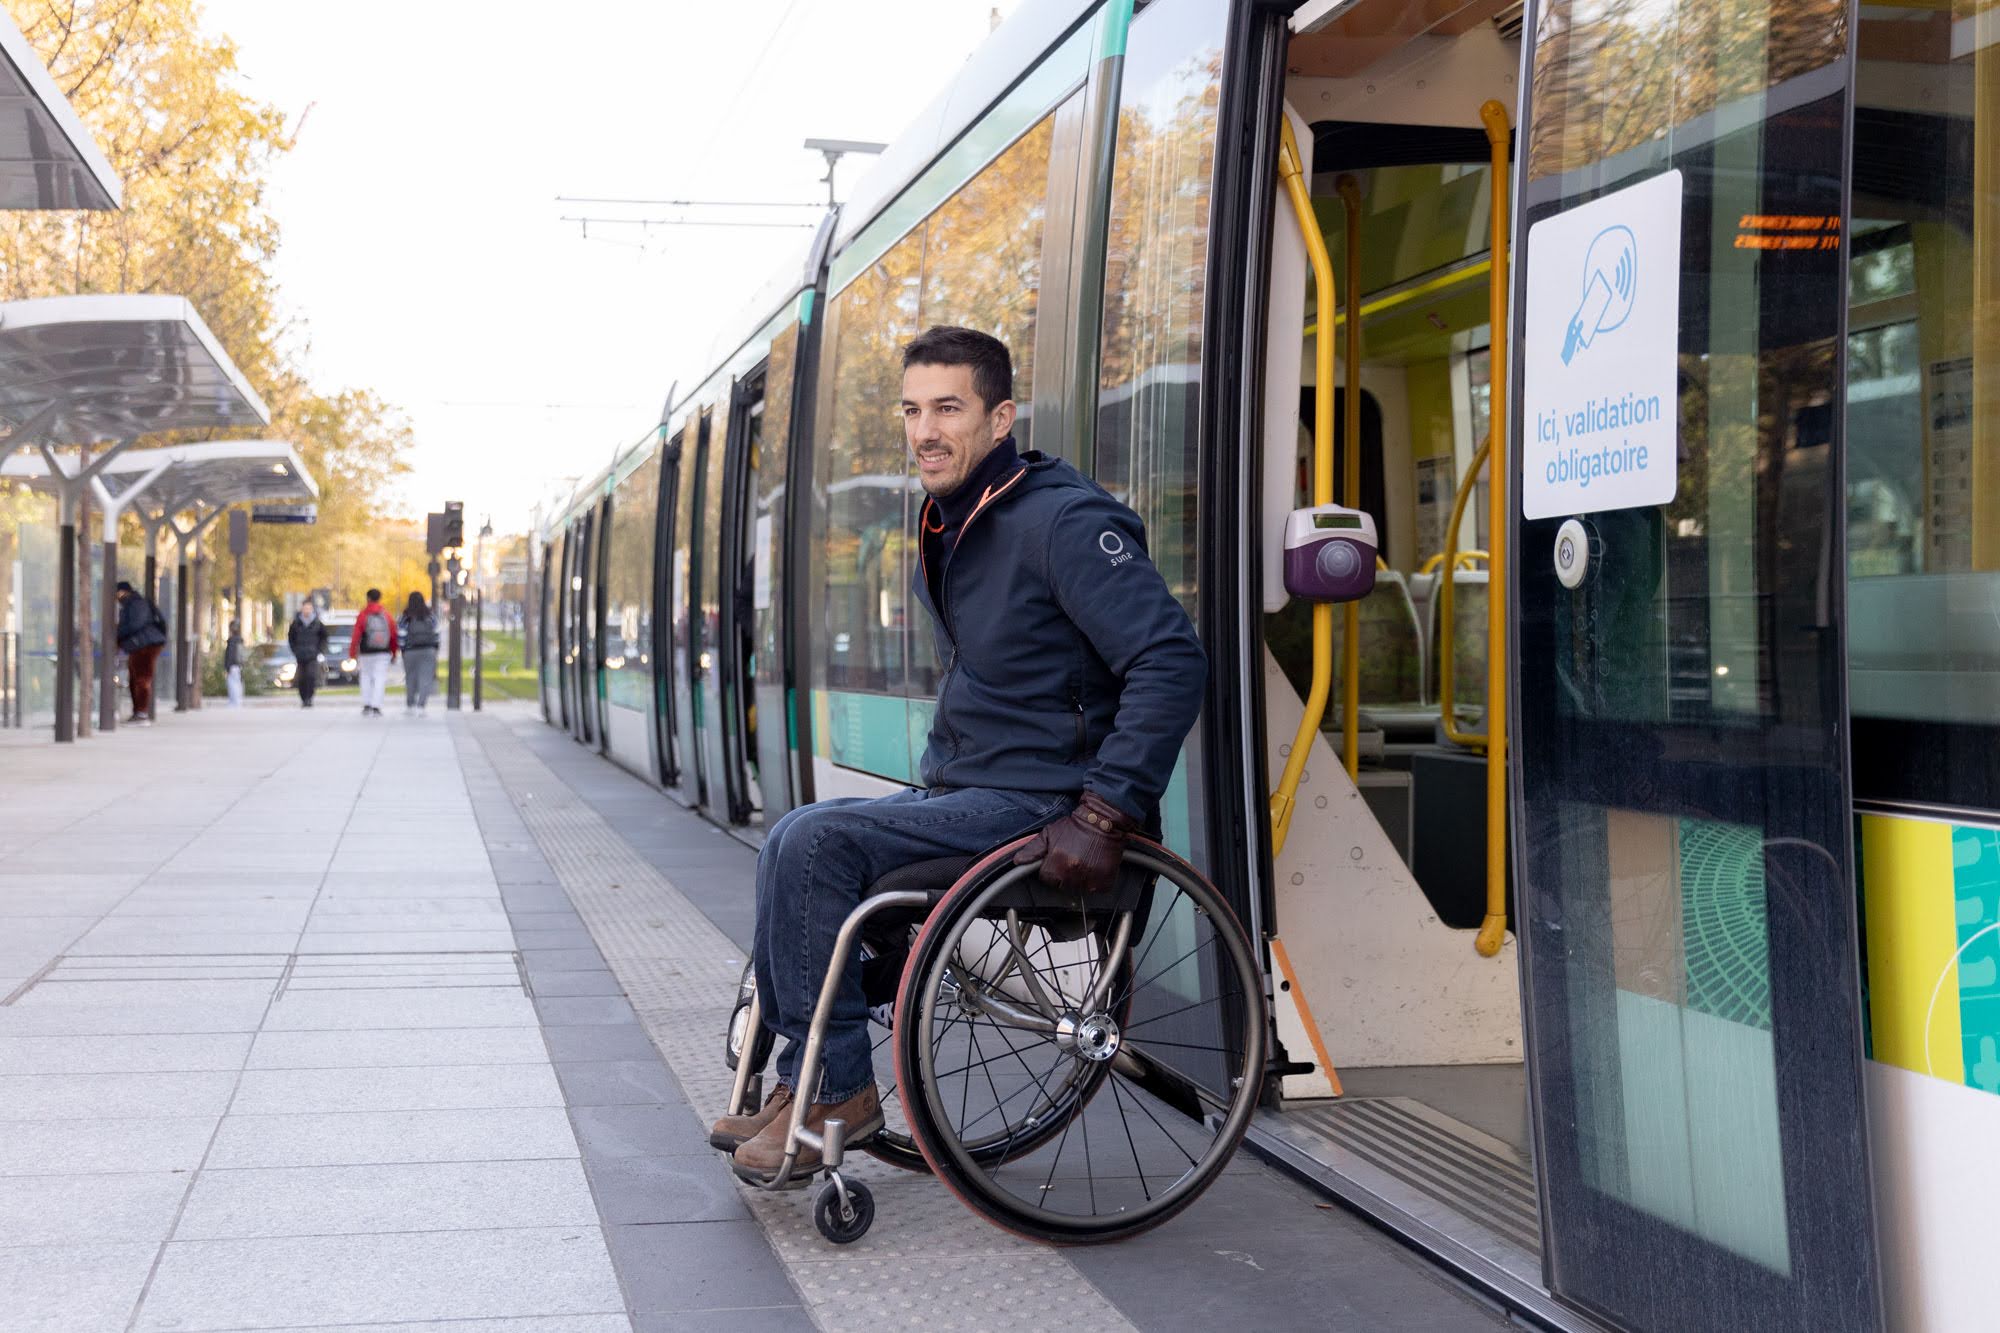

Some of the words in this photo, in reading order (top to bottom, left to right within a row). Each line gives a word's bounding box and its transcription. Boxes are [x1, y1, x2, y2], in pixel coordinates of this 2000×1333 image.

[1537, 408, 1561, 446] Ici,
[1565, 391, 1660, 438] validation
[1546, 439, 1648, 488] obligatoire
